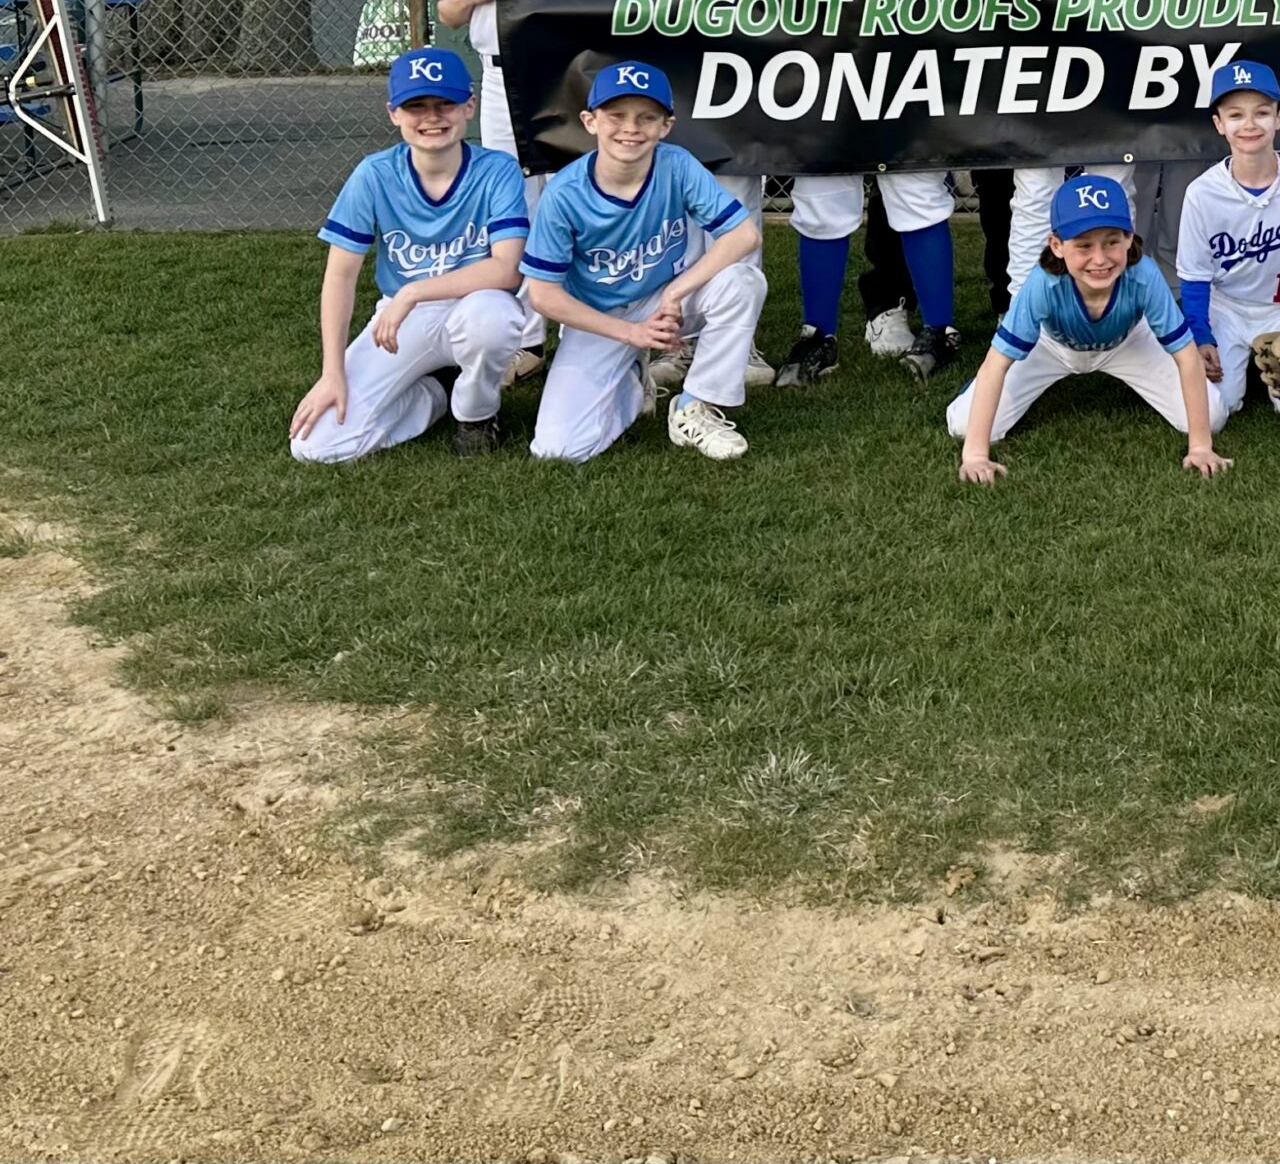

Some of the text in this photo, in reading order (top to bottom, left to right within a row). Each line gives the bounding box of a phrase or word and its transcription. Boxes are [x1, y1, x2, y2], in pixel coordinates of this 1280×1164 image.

[408, 57, 443, 82] KC
[615, 66, 650, 90] KC
[691, 42, 1242, 122] DONATED BY
[1233, 65, 1252, 85] LA
[1075, 185, 1110, 210] KC
[383, 221, 490, 277] Royals
